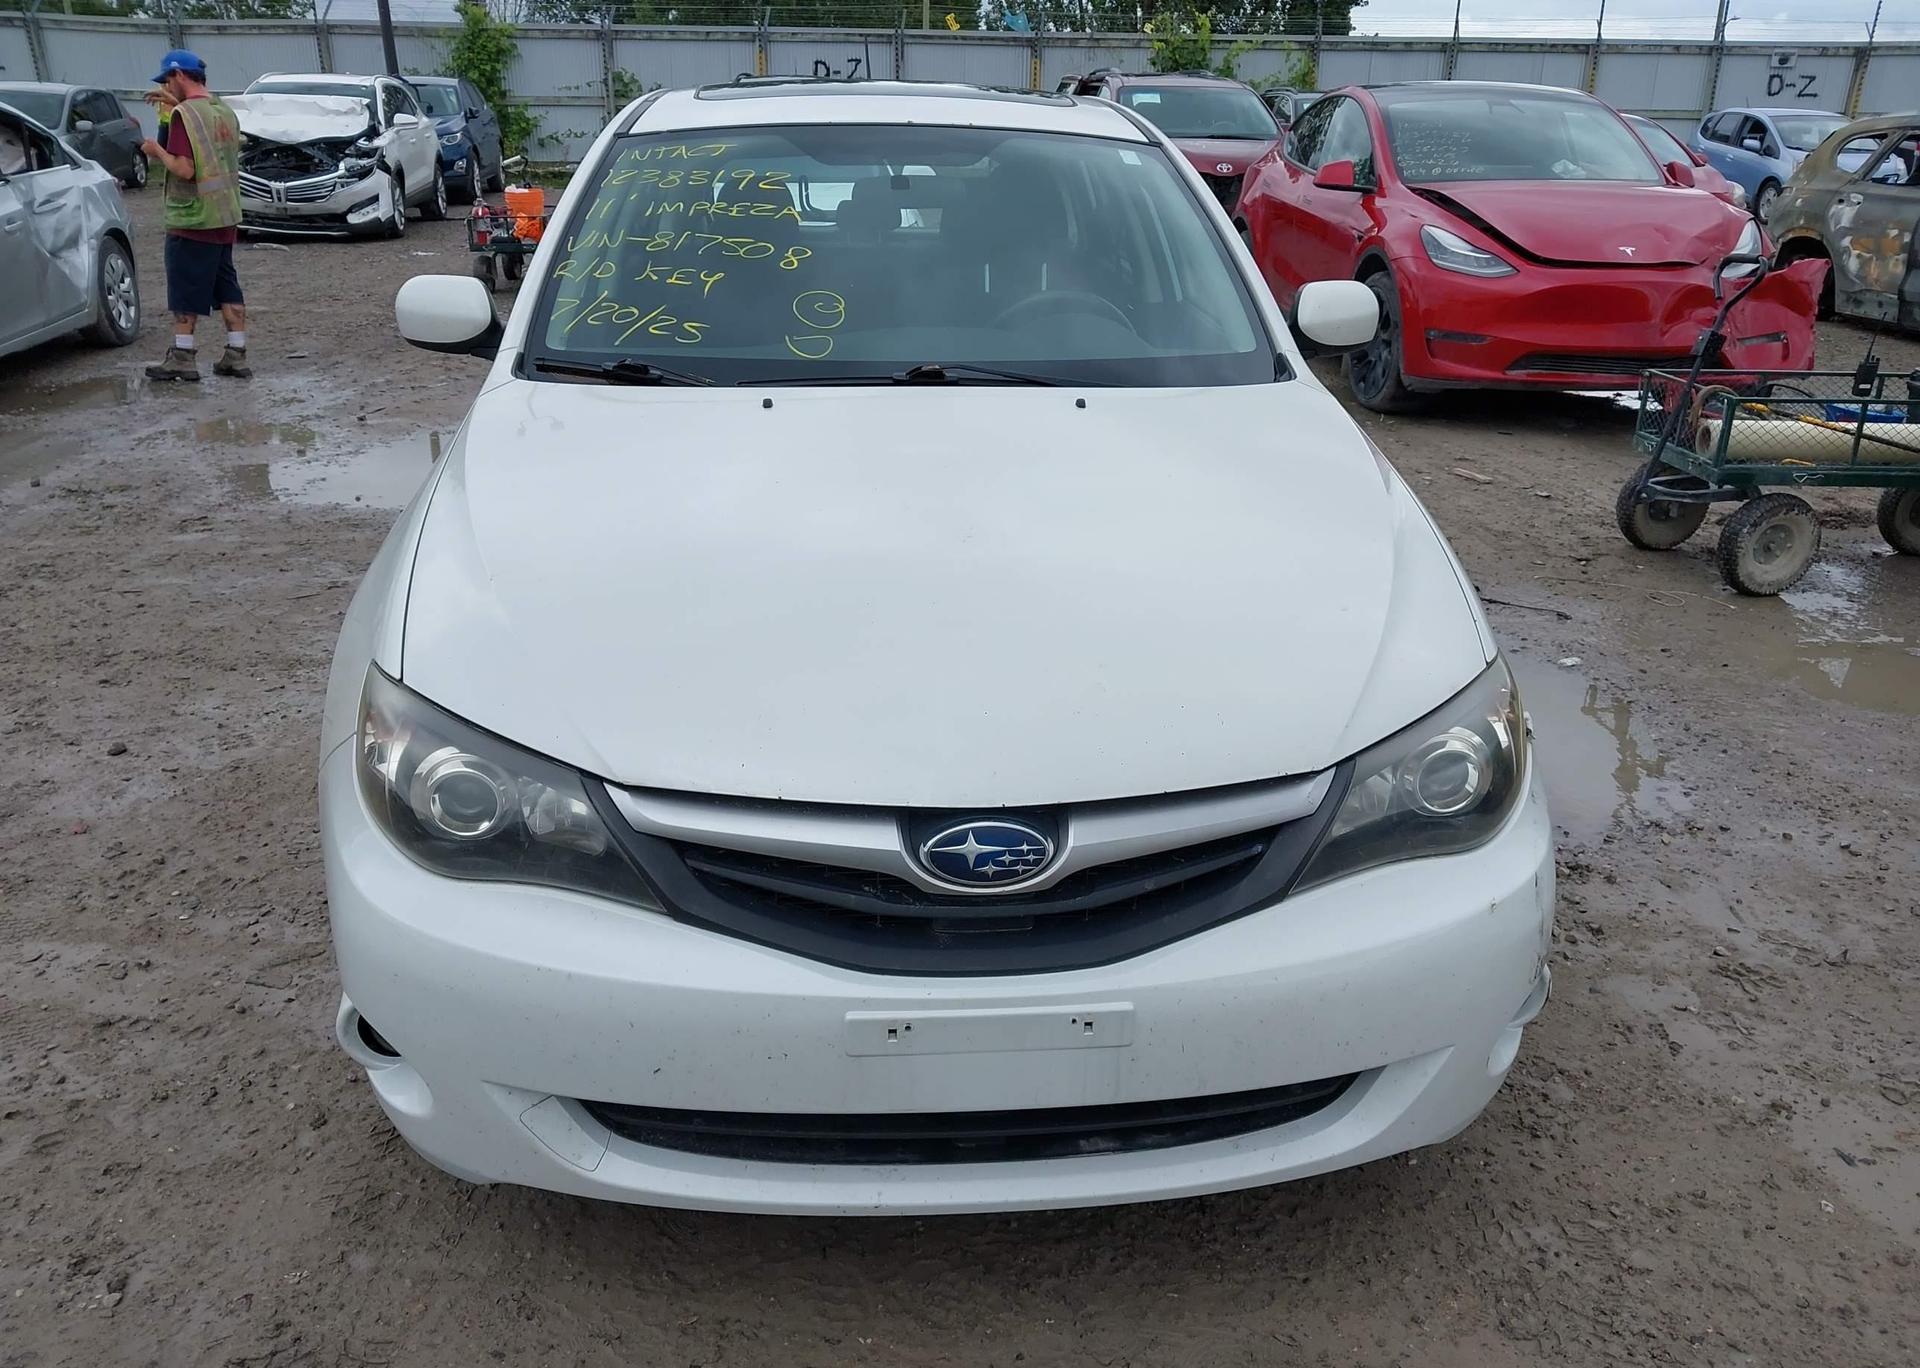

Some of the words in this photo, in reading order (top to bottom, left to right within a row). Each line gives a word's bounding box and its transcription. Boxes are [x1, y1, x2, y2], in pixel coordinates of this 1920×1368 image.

[1767, 73, 1818, 98] D-Z
[616, 144, 738, 163] INTACT
[600, 168, 792, 190] 12383192
[644, 200, 802, 225] IMPREZA
[634, 260, 726, 299] KEY
[550, 290, 711, 346] 7/20/25
